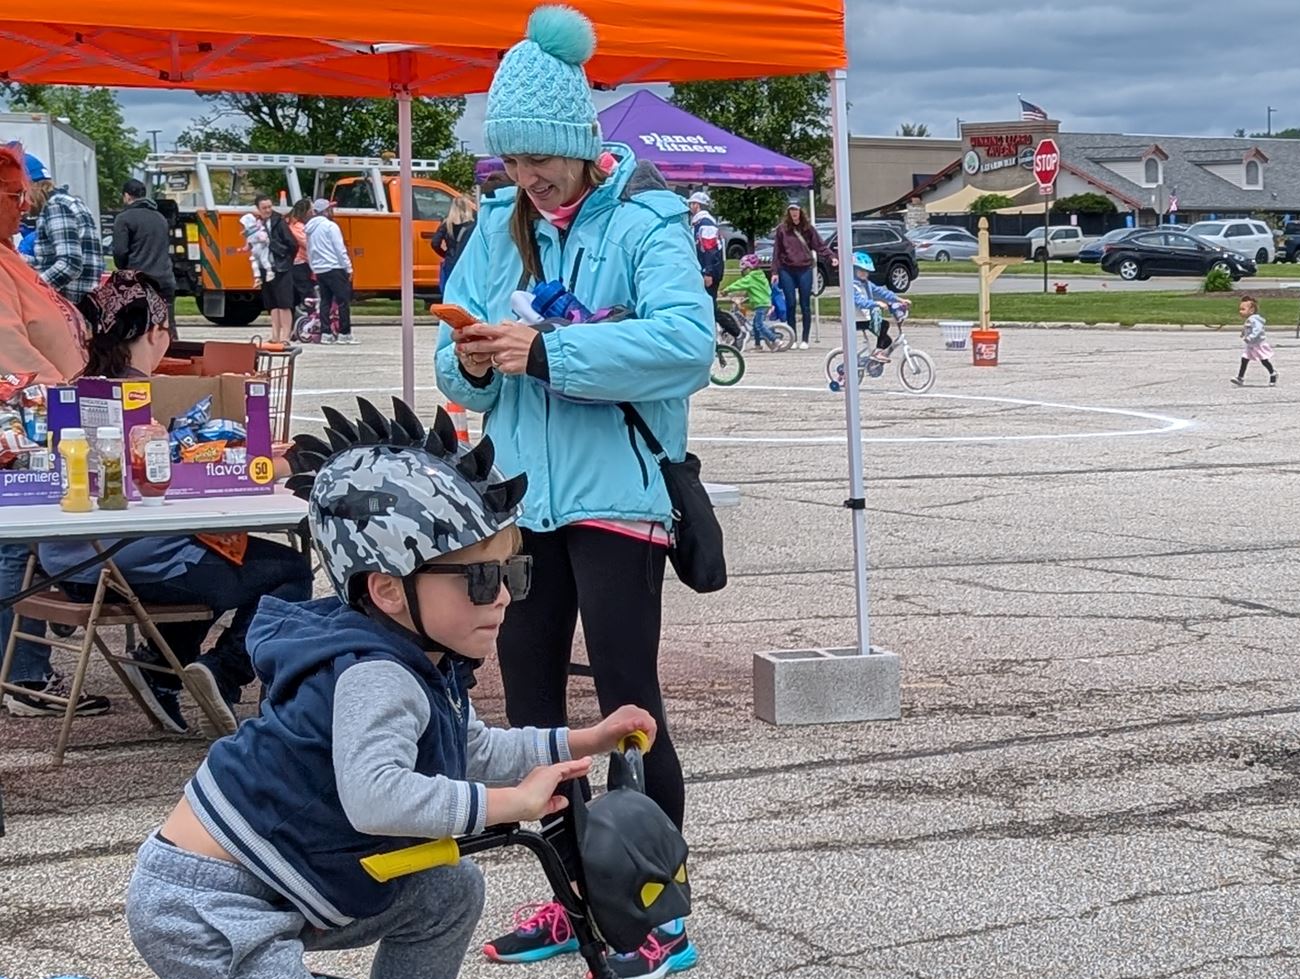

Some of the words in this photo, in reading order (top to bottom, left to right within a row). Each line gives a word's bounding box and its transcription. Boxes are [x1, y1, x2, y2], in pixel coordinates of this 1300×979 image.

[639, 132, 708, 145] planet
[657, 142, 728, 154] fitness
[1036, 153, 1057, 171] STOP
[206, 463, 247, 476] flavor
[255, 462, 268, 475] 50
[4, 471, 60, 486] premiere
